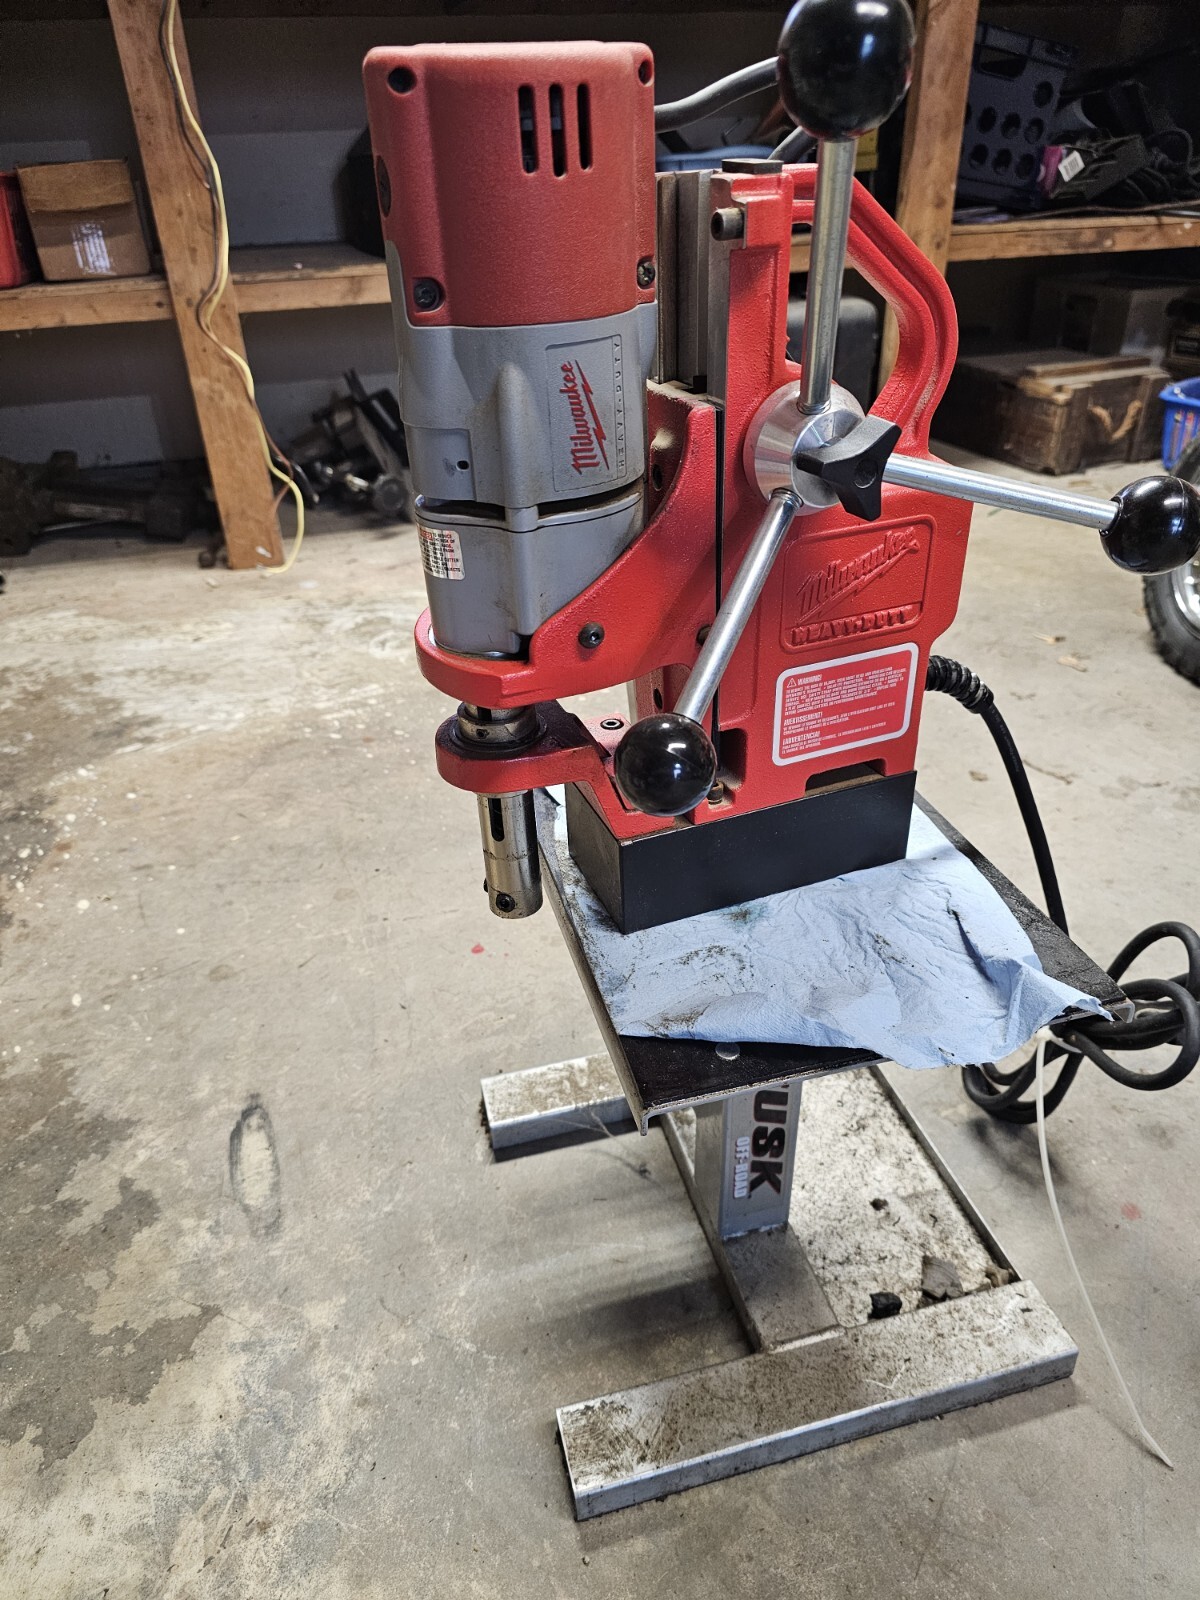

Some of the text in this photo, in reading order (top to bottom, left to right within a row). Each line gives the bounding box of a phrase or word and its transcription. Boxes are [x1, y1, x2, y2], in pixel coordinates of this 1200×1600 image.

[559, 360, 600, 475] Milwaukee
[796, 527, 918, 616] Milwaukee
[791, 604, 913, 647] HEAVY-DUTY
[733, 1136, 750, 1199] OFF-ROAD
[750, 1084, 789, 1195] USK
